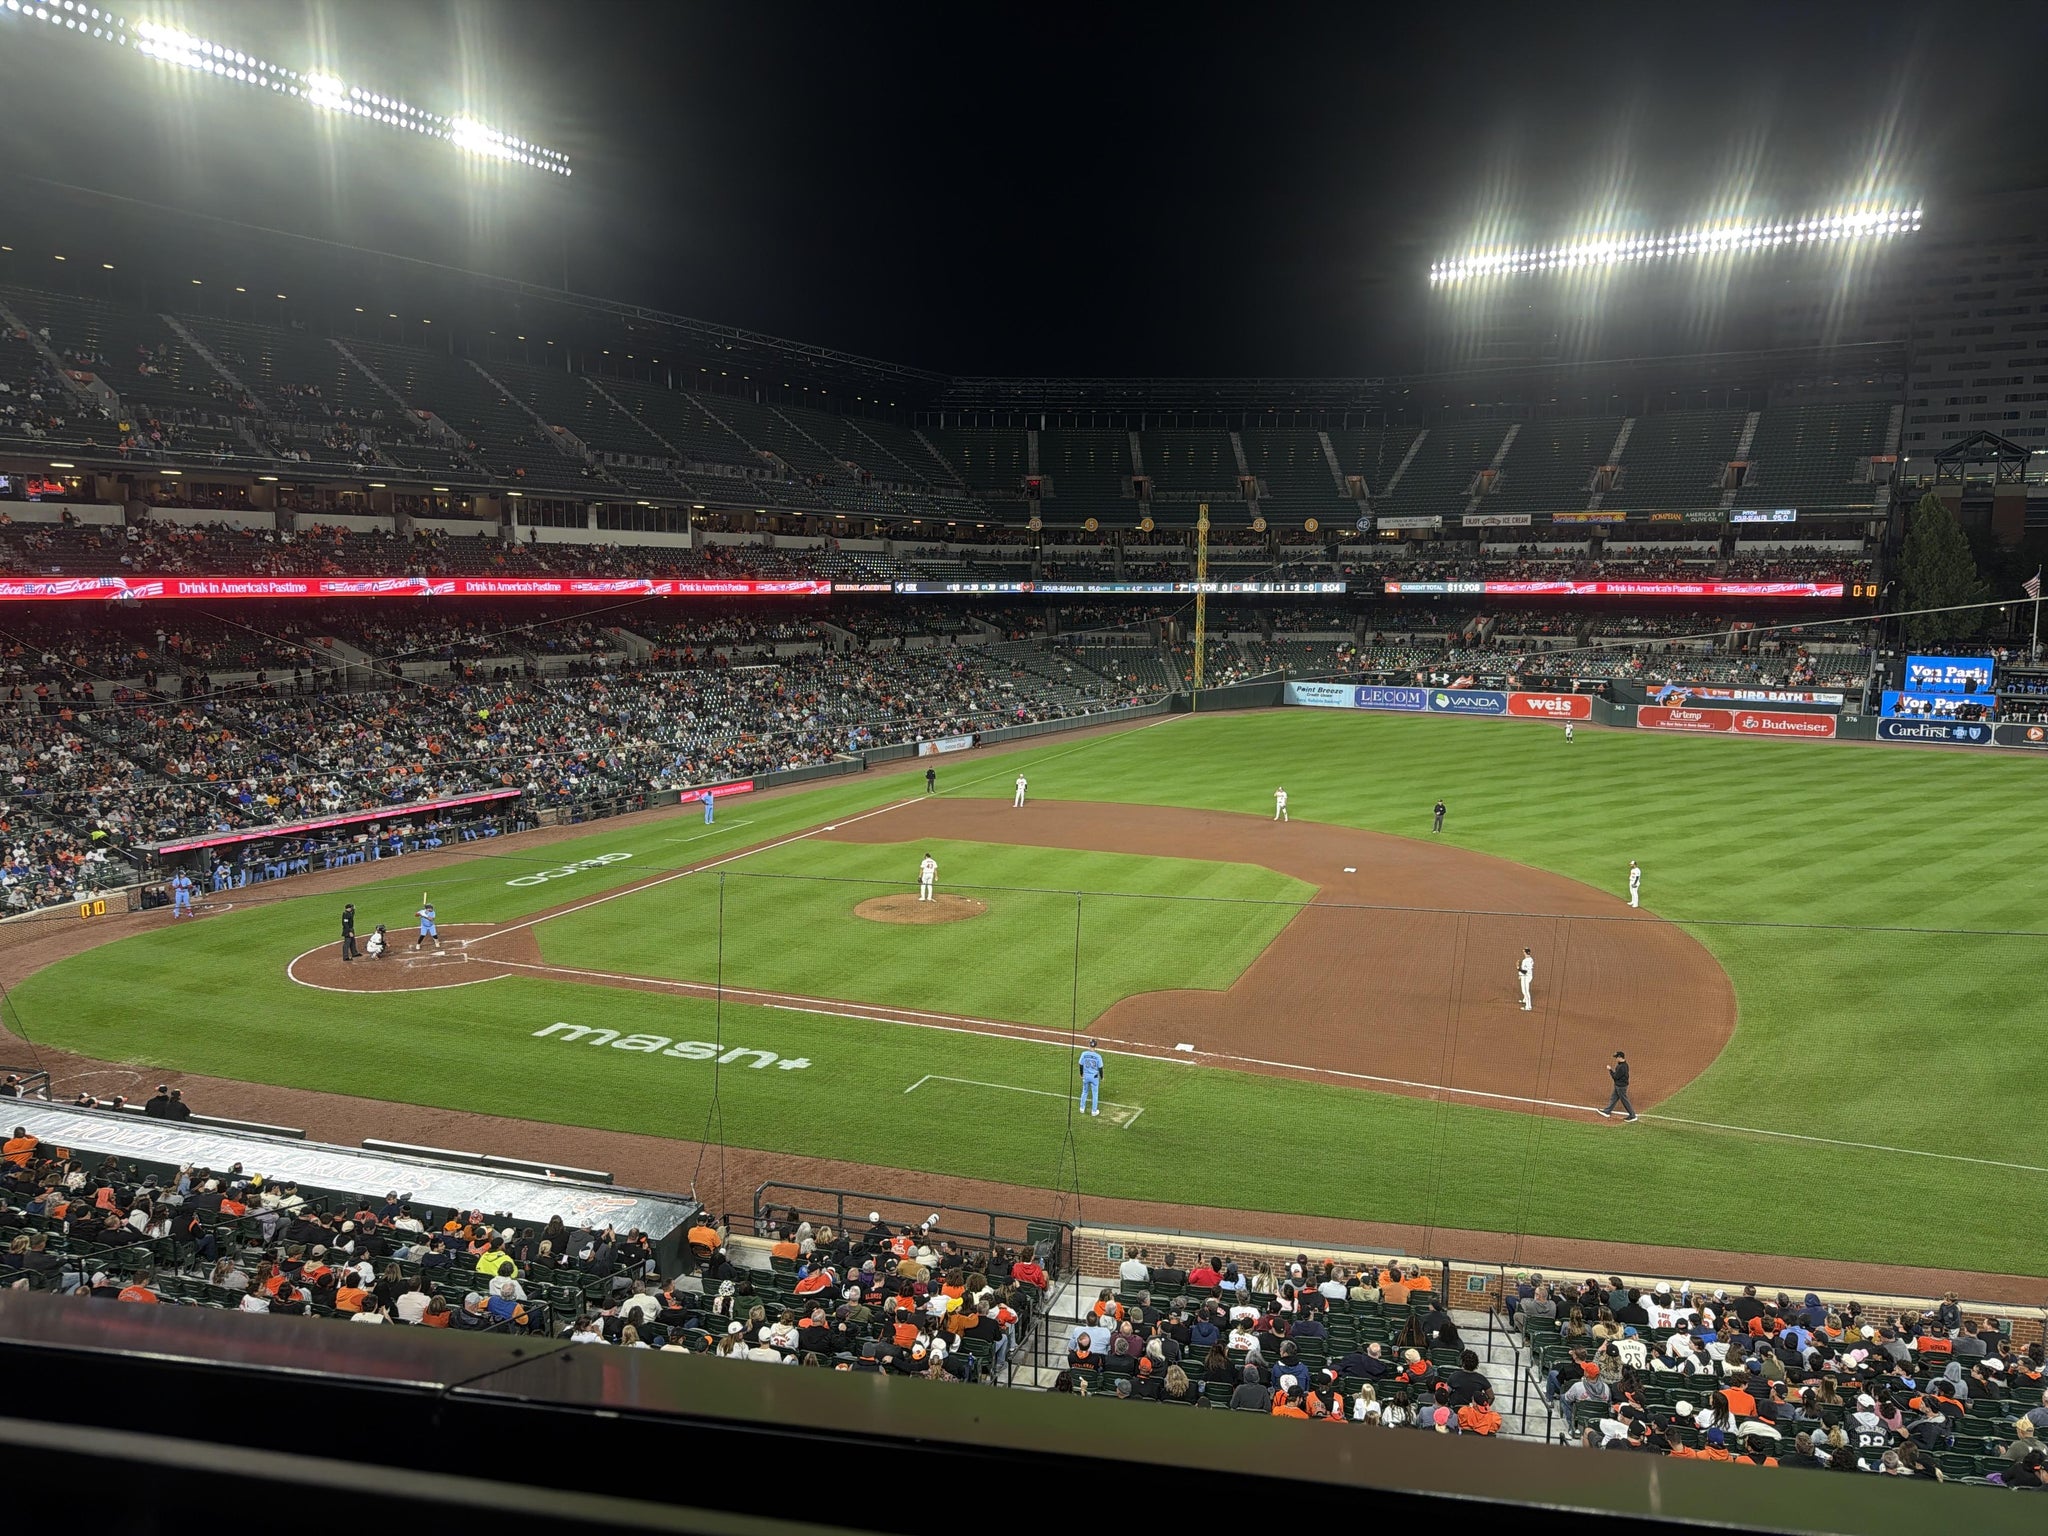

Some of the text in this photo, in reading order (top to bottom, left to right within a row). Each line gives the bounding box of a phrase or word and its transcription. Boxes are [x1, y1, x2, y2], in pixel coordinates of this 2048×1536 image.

[1358, 520, 1368, 529] 42
[179, 581, 307, 594] Drink in America's Pastime
[466, 582, 488, 592] Drink
[497, 582, 532, 592] America's
[532, 581, 561, 592] Pastime
[1201, 583, 1217, 592] TOR
[1243, 584, 1258, 592] BAL
[1322, 584, 1340, 592] 8:04
[1447, 583, 1480, 593] $11,908
[1606, 584, 1627, 592] Drink
[1636, 584, 1672, 593] America's
[1672, 585, 1703, 593] Pastime
[1852, 584, 1877, 597] 0:10
[1911, 665, 1988, 680] Von Paris
[1317, 687, 1344, 695] Breeze
[1361, 690, 1420, 703] LECOM
[1733, 690, 1803, 702] BIRD BATH
[1450, 696, 1500, 708] VANDA
[1526, 697, 1572, 711] weis
[1670, 710, 1702, 720] Airtemp
[1889, 723, 1950, 739] CareFirst
[53, 1120, 164, 1150] HOME
[279, 1155, 442, 1192] ORIOLES
[773, 1338, 786, 1347] 35
[1625, 1353, 1642, 1369] 25
